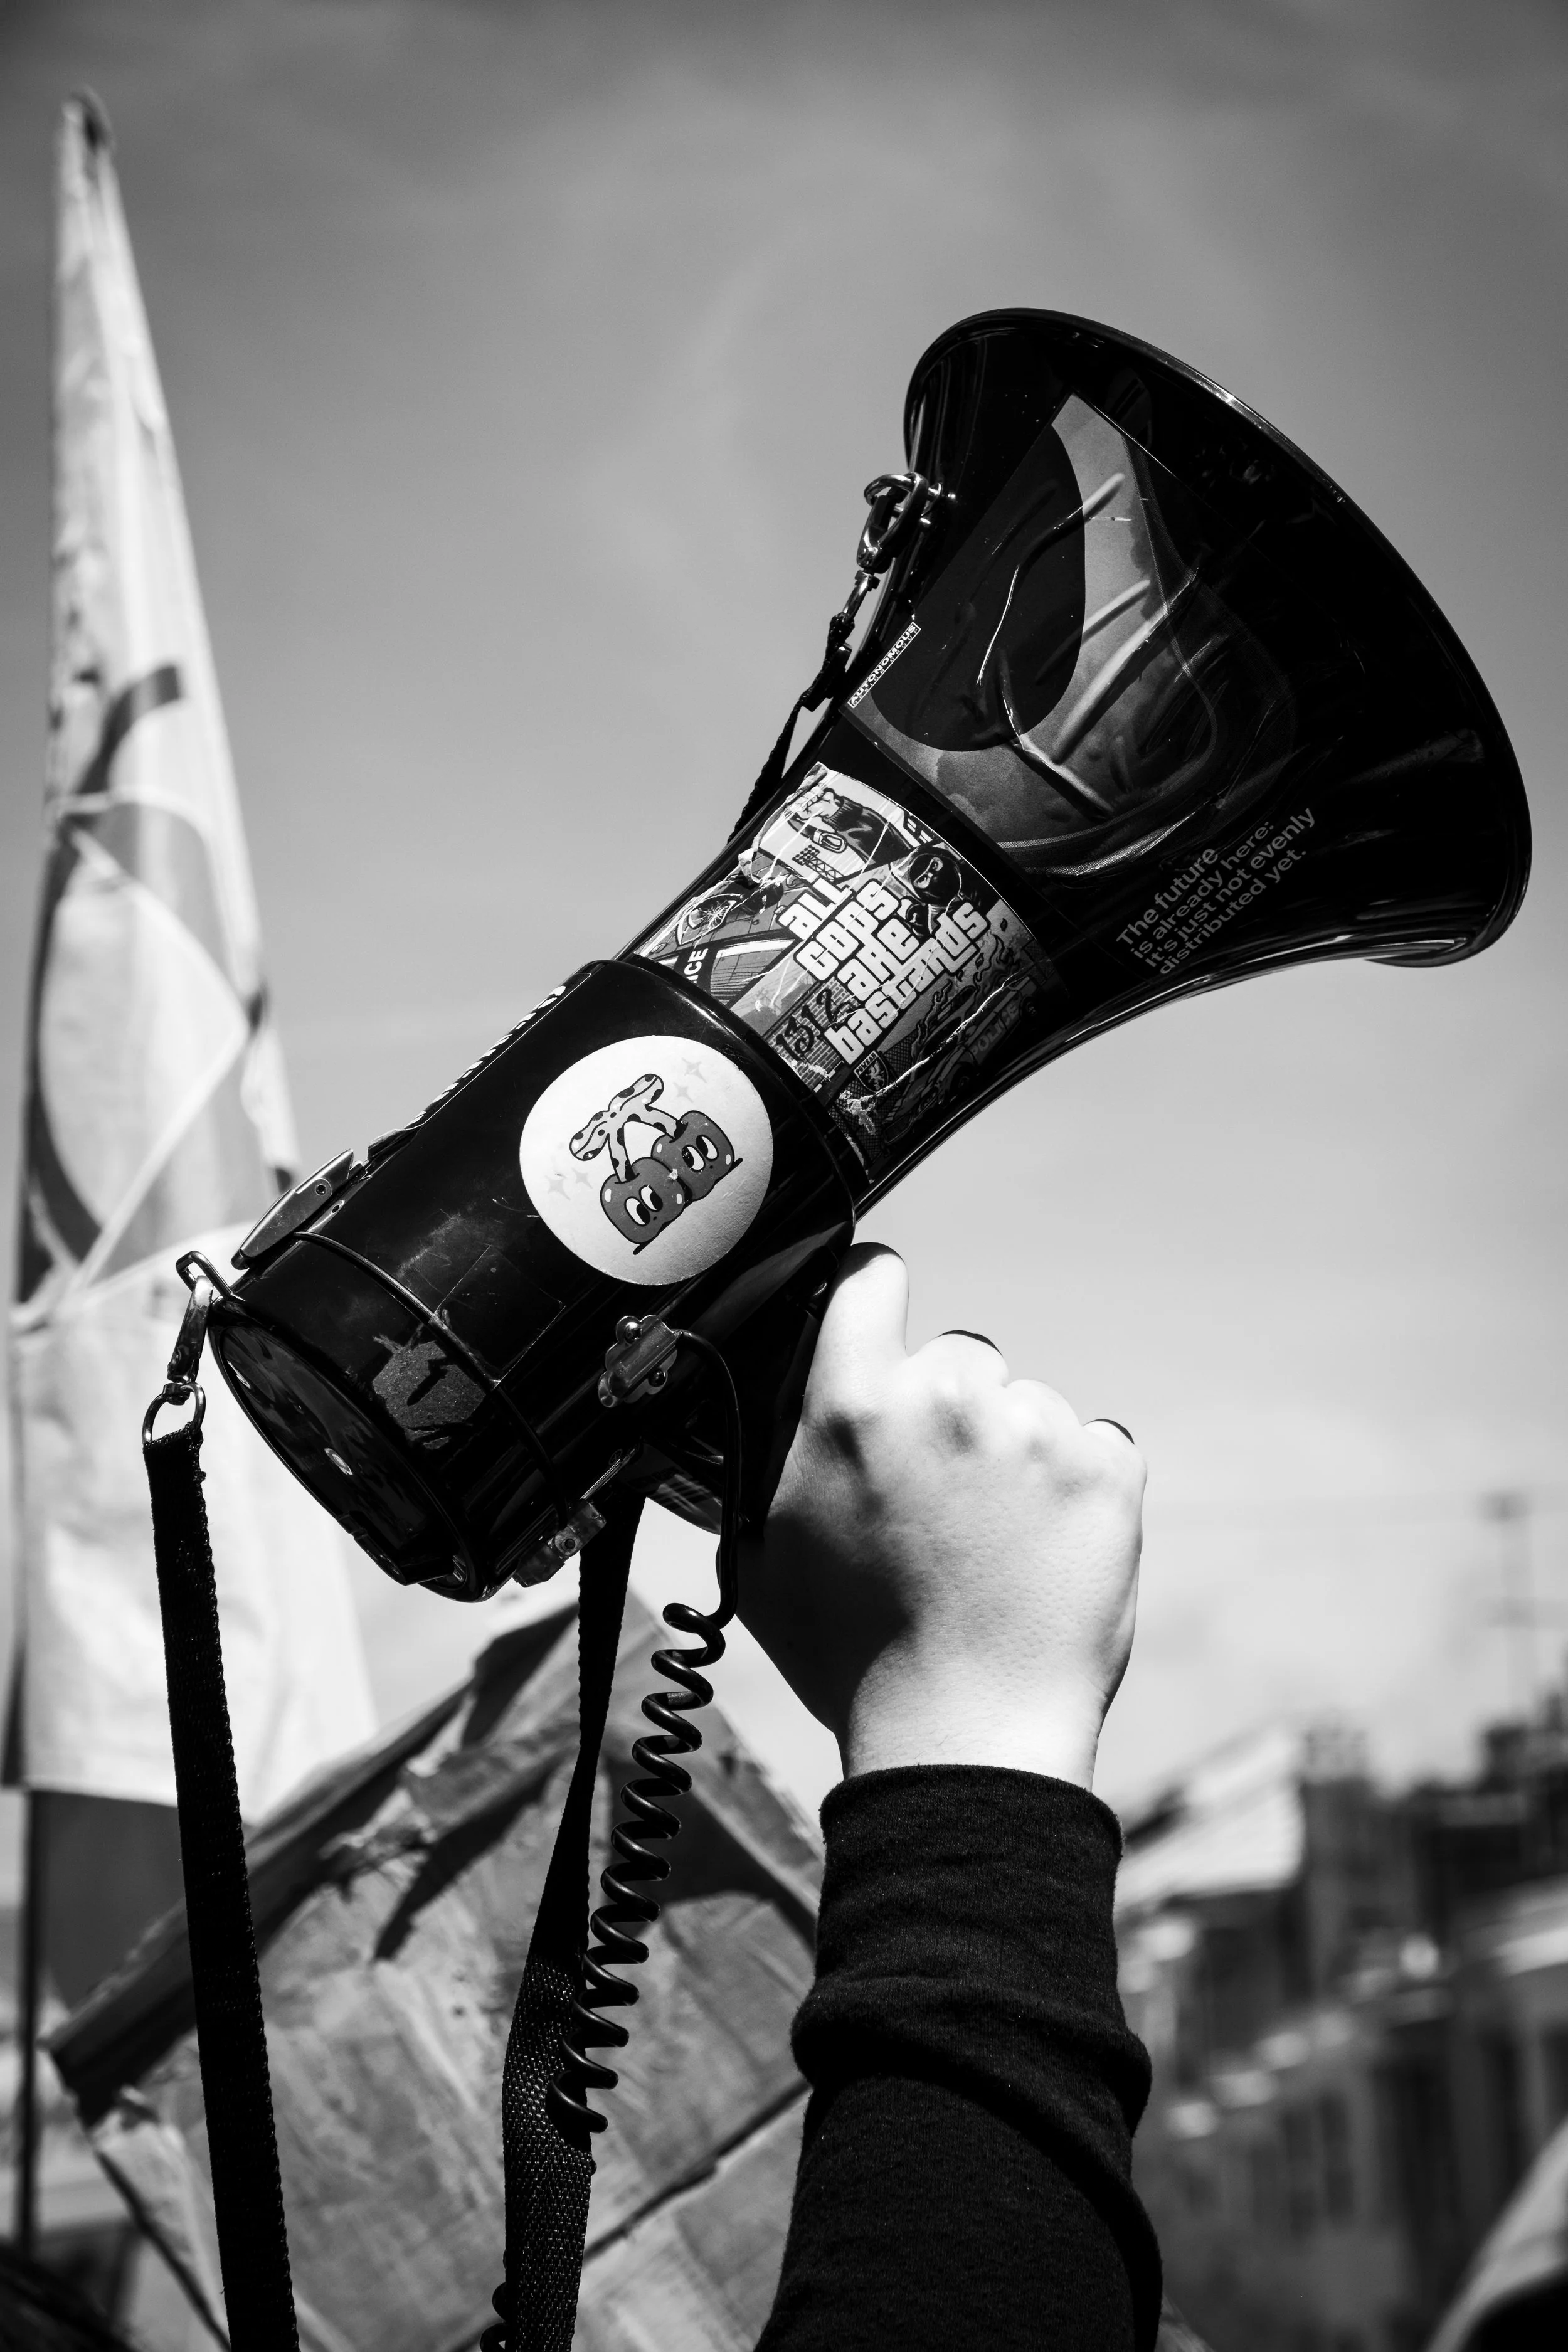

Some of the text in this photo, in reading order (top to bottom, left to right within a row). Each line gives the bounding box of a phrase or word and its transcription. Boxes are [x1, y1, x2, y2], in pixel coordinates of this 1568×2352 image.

[850, 624, 916, 704] AUTONOMOUS
[889, 628, 918, 662] GROUP
[1116, 847, 1219, 945] The future
[1130, 820, 1274, 958] is already here:
[1145, 807, 1316, 967] It's just not evenly
[1160, 847, 1307, 975] distributed yet.
[775, 988, 854, 1062] 1312
[972, 1002, 1020, 1056] POLICE
